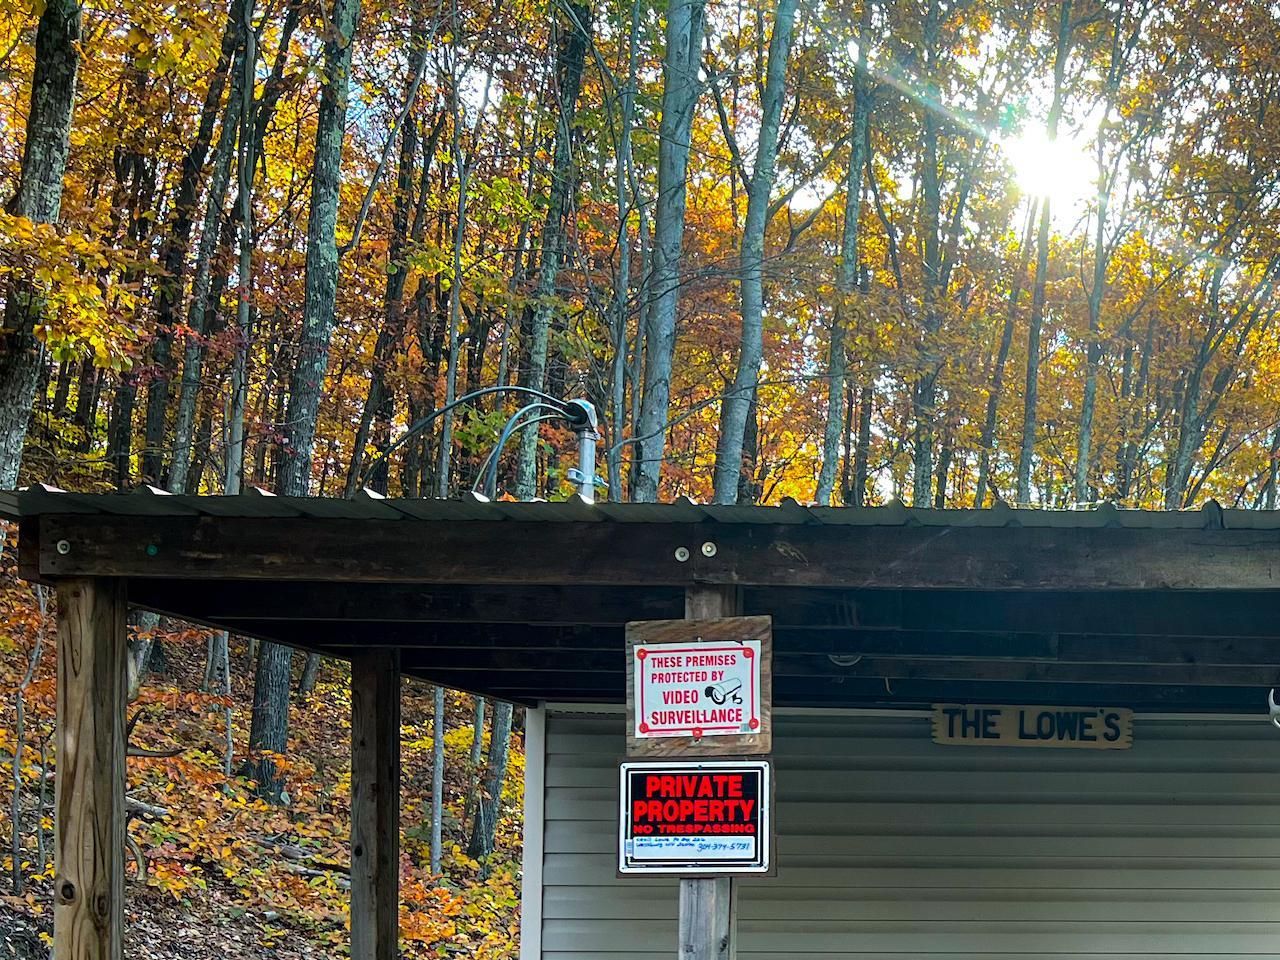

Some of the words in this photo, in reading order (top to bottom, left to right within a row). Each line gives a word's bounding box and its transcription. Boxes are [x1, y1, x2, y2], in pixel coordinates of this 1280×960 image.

[651, 656, 682, 668] THESE
[685, 654, 736, 667] PREMISES
[651, 671, 708, 683] PROTECTED
[711, 670, 724, 681] BY
[663, 690, 698, 705] VIDEO
[651, 708, 743, 725] SURVEILLANCE
[942, 708, 1001, 739] THE
[1018, 708, 1121, 742] LOWE'S
[646, 775, 743, 797] PRIVATE
[633, 799, 755, 822] PROPERTY
[633, 825, 653, 834] NO
[657, 824, 755, 833] TRESPASSING
